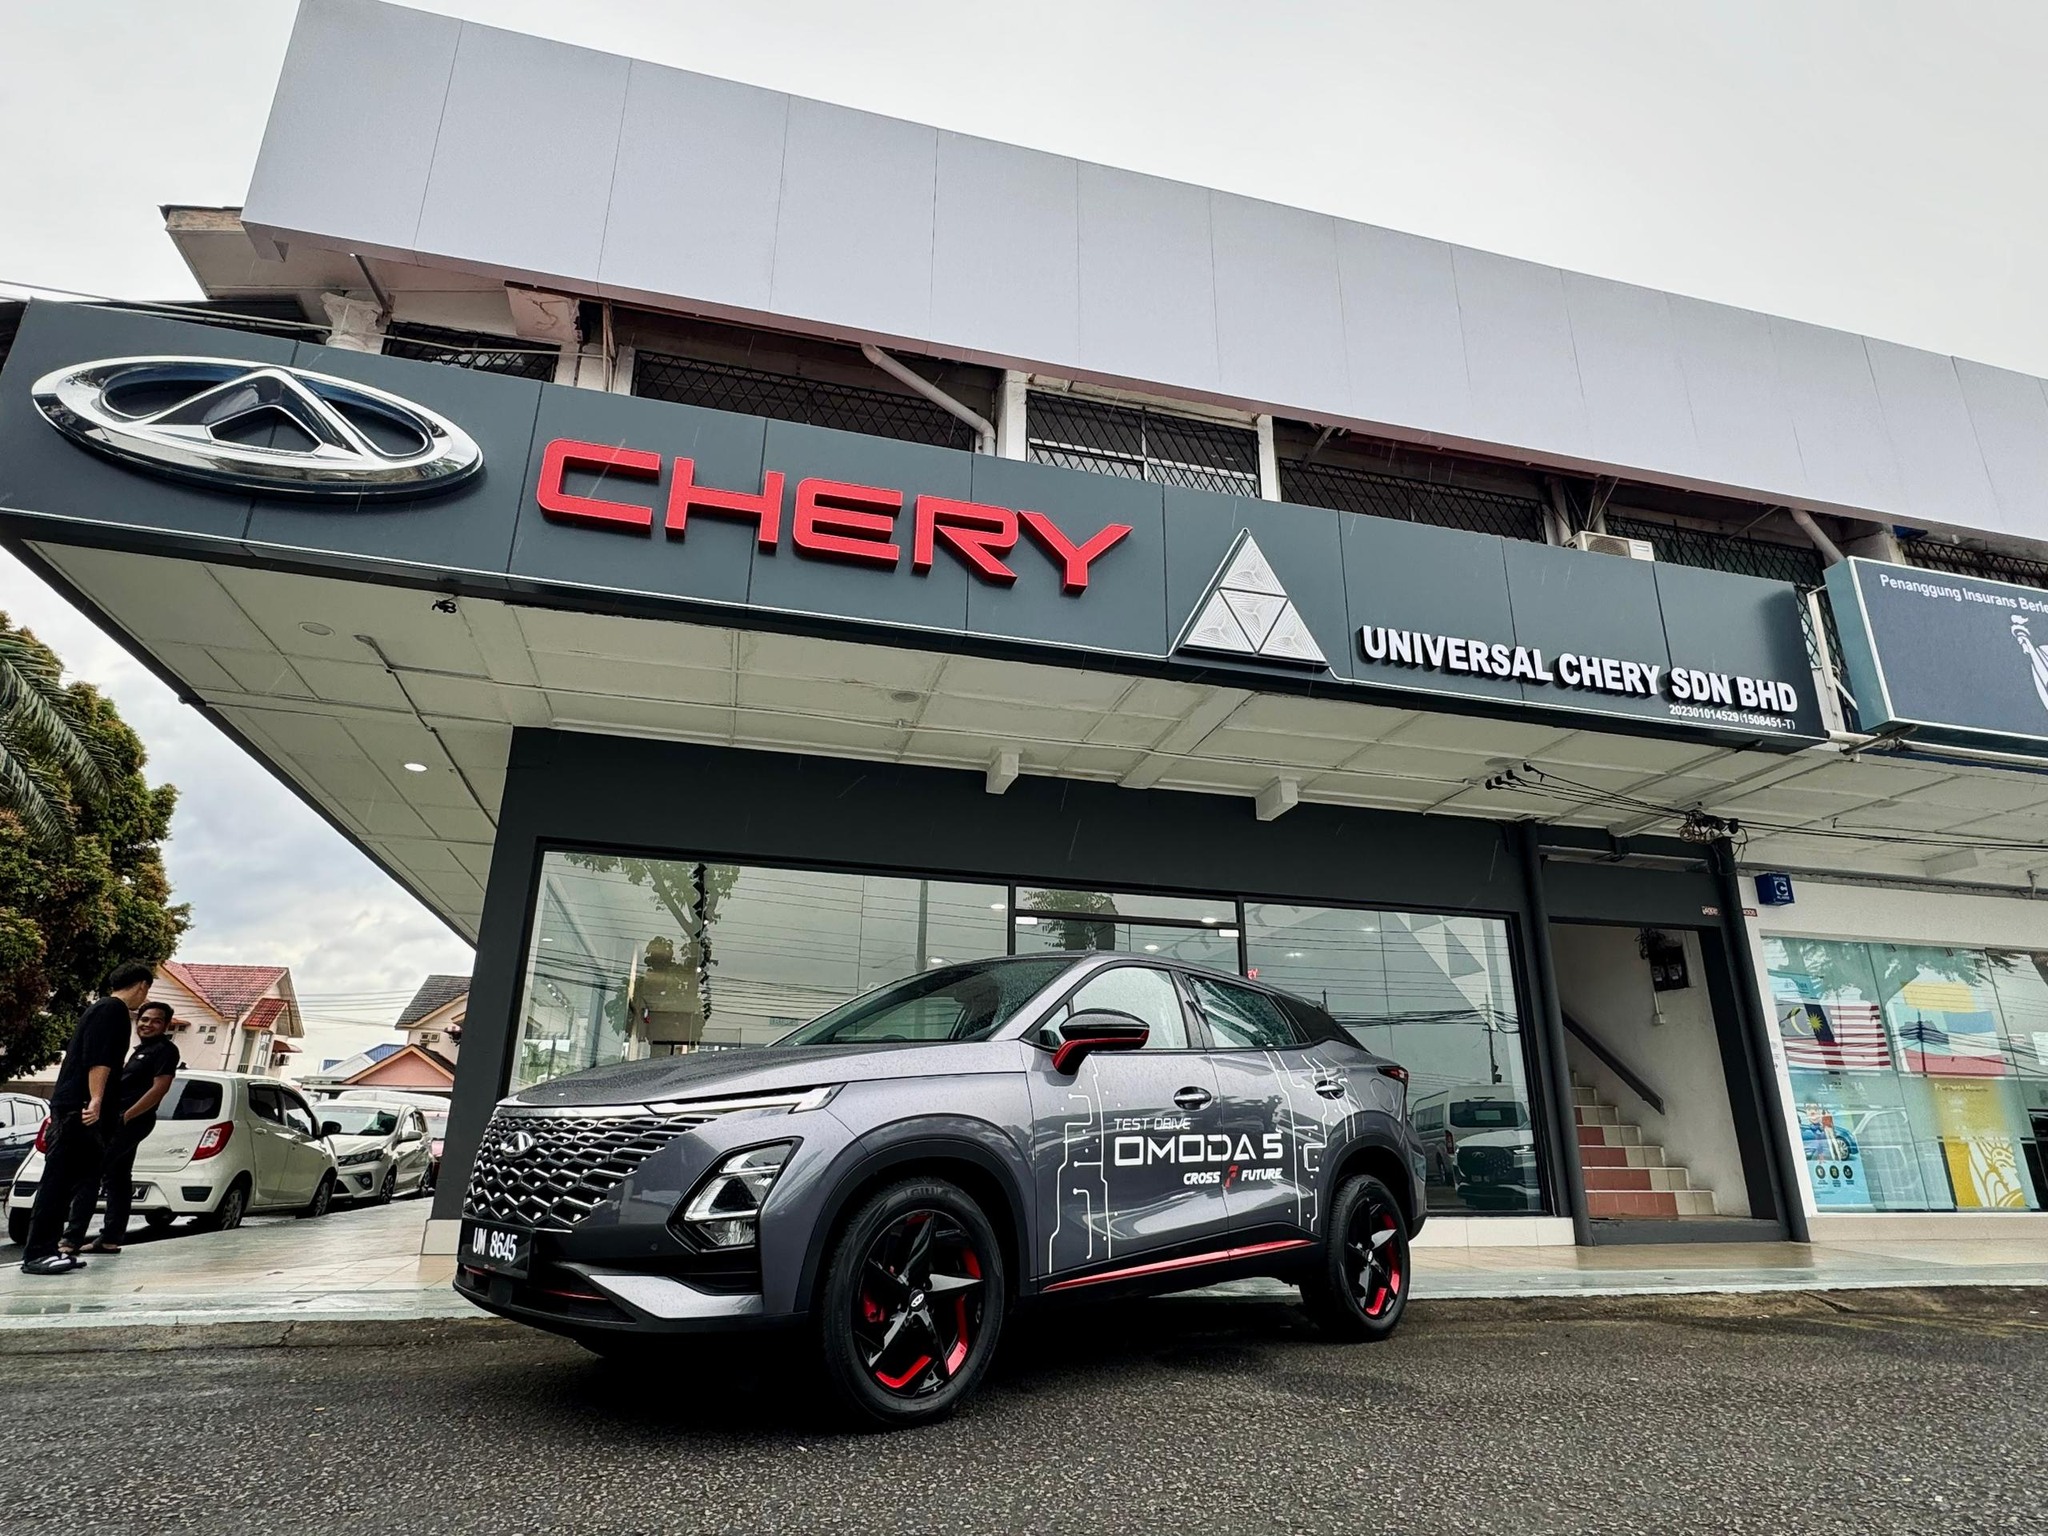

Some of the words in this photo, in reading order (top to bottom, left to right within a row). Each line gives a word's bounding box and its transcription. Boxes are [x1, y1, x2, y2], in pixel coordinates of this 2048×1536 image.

[536, 438, 1134, 595] CHERY
[1879, 573, 1962, 602] Penanggung
[1963, 588, 2018, 608] Insurans
[1361, 625, 1554, 682] UNIVERSAL
[1558, 652, 1661, 695] CHERY
[1670, 667, 1733, 705] SDN
[1736, 676, 1798, 713] BHD
[1114, 1118, 1152, 1131] TEST
[1154, 1117, 1192, 1131] DRIVE
[1114, 1134, 1257, 1167] OMODA
[1262, 1133, 1284, 1160] 5
[1183, 1171, 1221, 1186] CROSS
[1241, 1167, 1283, 1182] FUTURE
[489, 1230, 518, 1262] 8645
